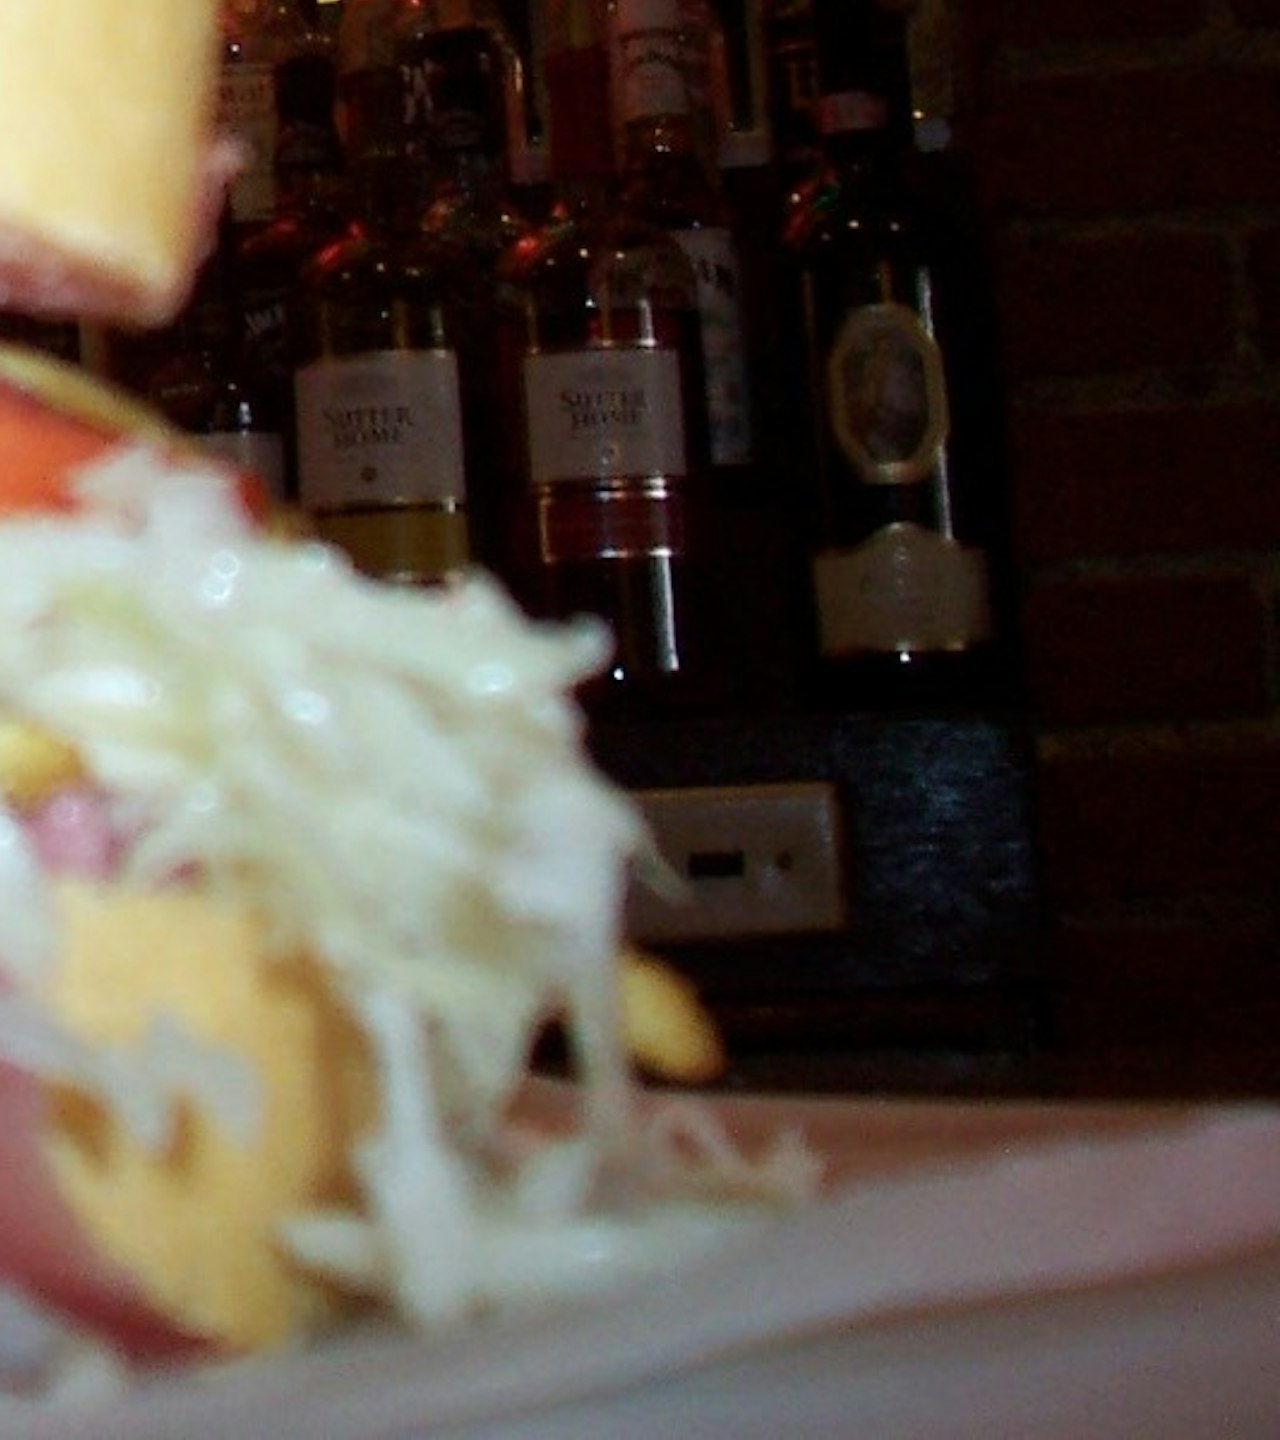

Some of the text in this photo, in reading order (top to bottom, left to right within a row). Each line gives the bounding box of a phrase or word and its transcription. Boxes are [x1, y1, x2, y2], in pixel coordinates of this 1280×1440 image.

[560, 388, 648, 410] SUTTER
[321, 406, 414, 428] SUTTER
[570, 409, 638, 430] HOME
[333, 427, 401, 448] HOME
